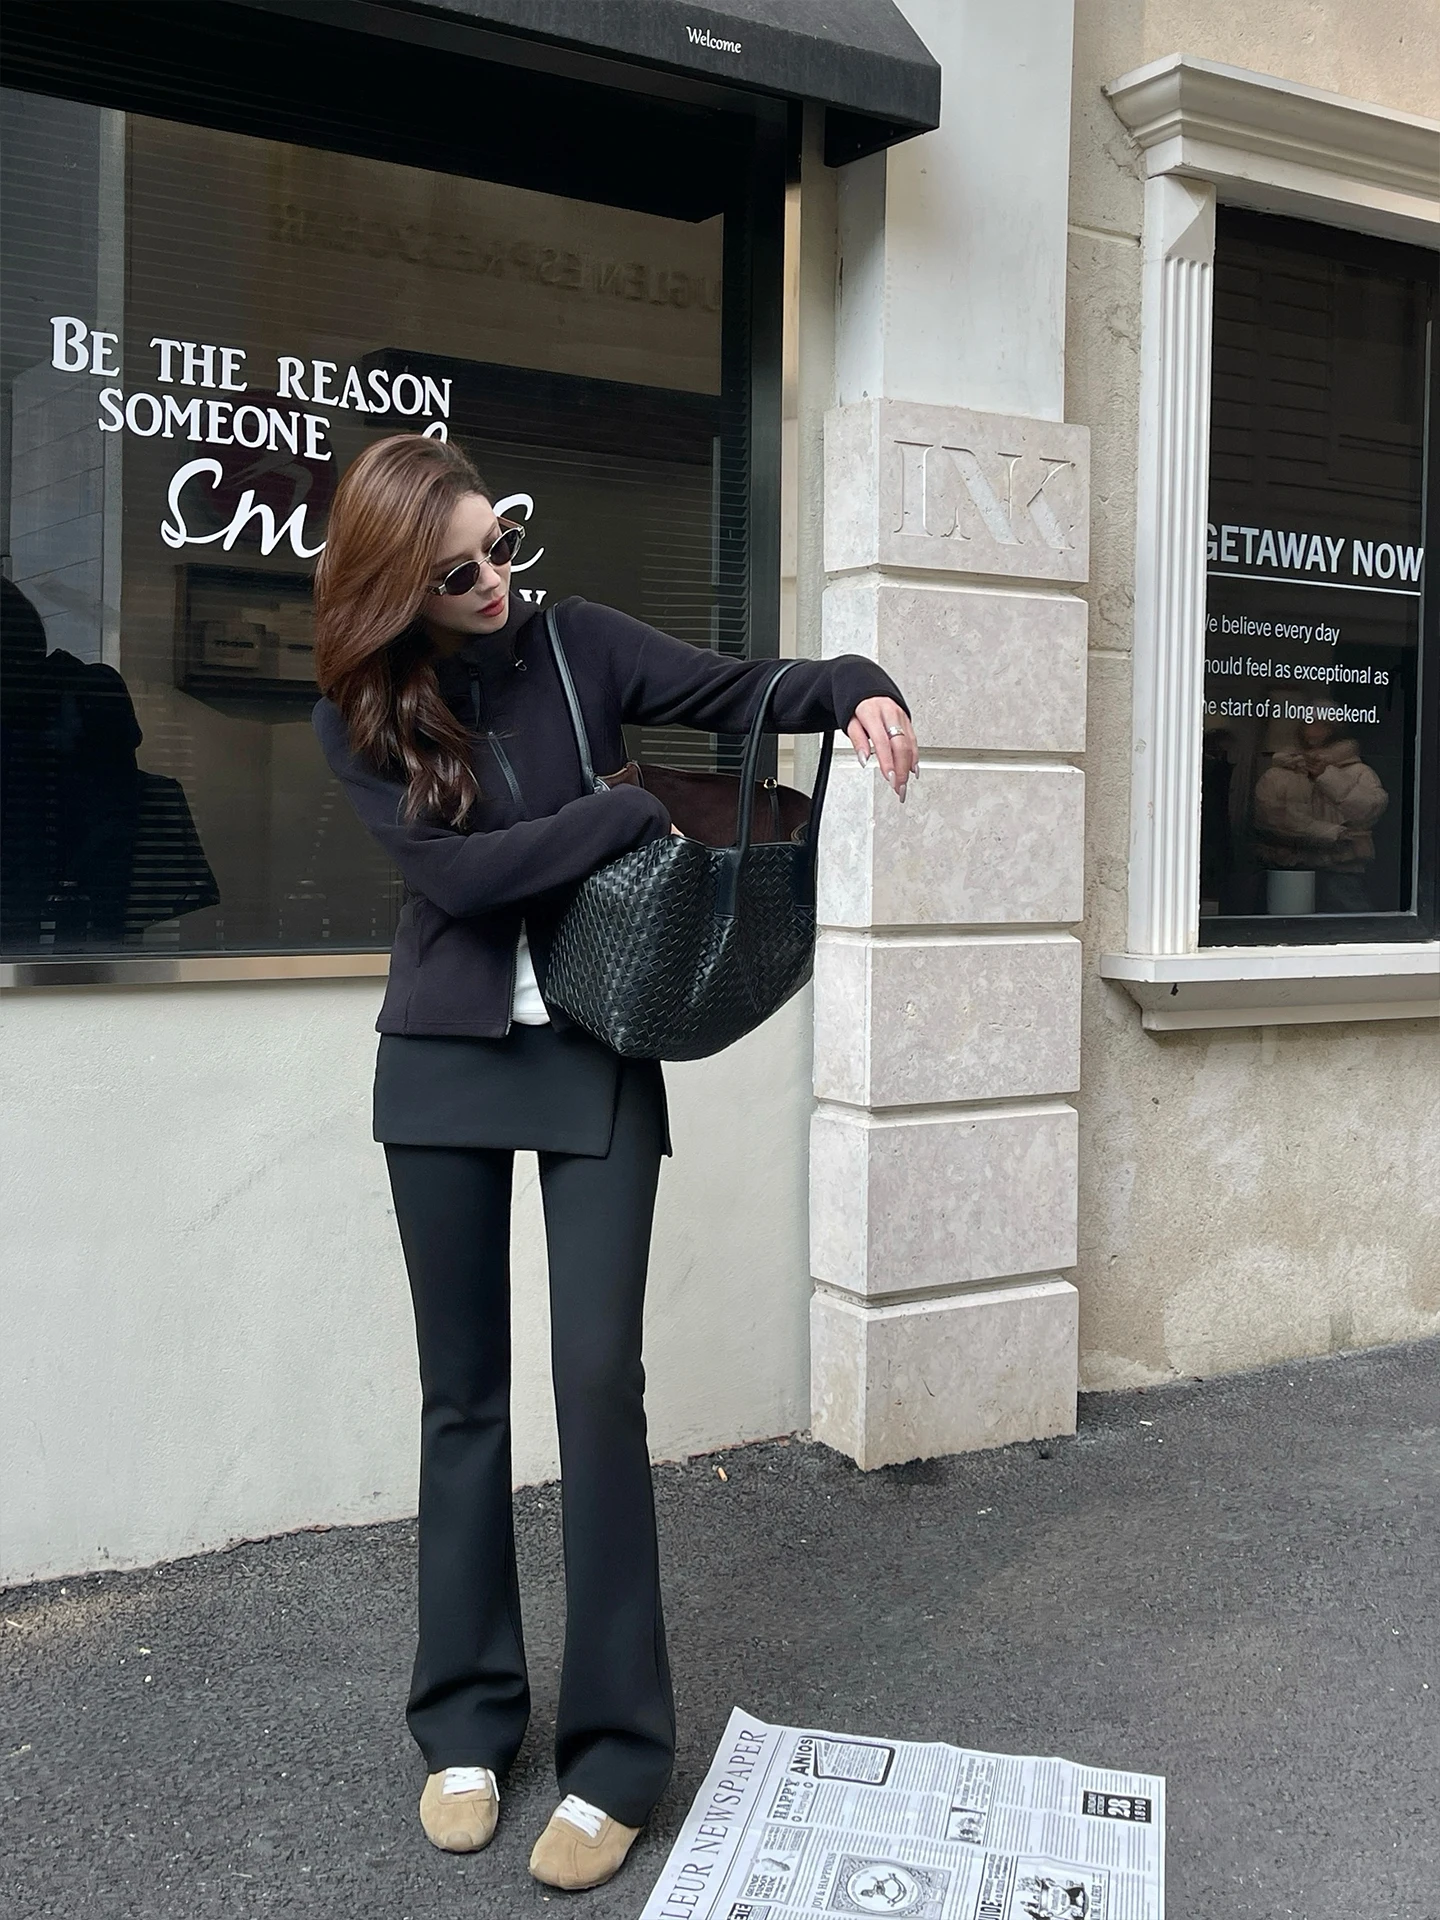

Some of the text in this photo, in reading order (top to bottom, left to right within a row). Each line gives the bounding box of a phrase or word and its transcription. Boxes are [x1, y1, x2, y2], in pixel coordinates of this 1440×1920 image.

[685, 25, 742, 54] Welcome
[49, 315, 453, 419] BE THE REASON
[97, 387, 332, 461] SOMEONE
[160, 421, 545, 573] Sme
[893, 439, 1076, 551] INK
[1206, 522, 1424, 582] GETAWAY NOW
[1205, 613, 1340, 646] e believe every day
[1204, 656, 1389, 685] hould feel as exceptional as
[1220, 698, 1253, 717] start
[1256, 699, 1270, 718] of
[1272, 705, 1281, 719] a
[1284, 700, 1314, 724] long
[1316, 703, 1381, 724] weekend.
[790, 1738, 814, 1776] ANIOS
[690, 1729, 768, 1856] NEWSPAPER
[772, 1777, 800, 1820] HAPPY
[1107, 1798, 1132, 1818] 28
[811, 1895, 823, 1911] JOY
[820, 1853, 838, 1890] HAPPINESS
